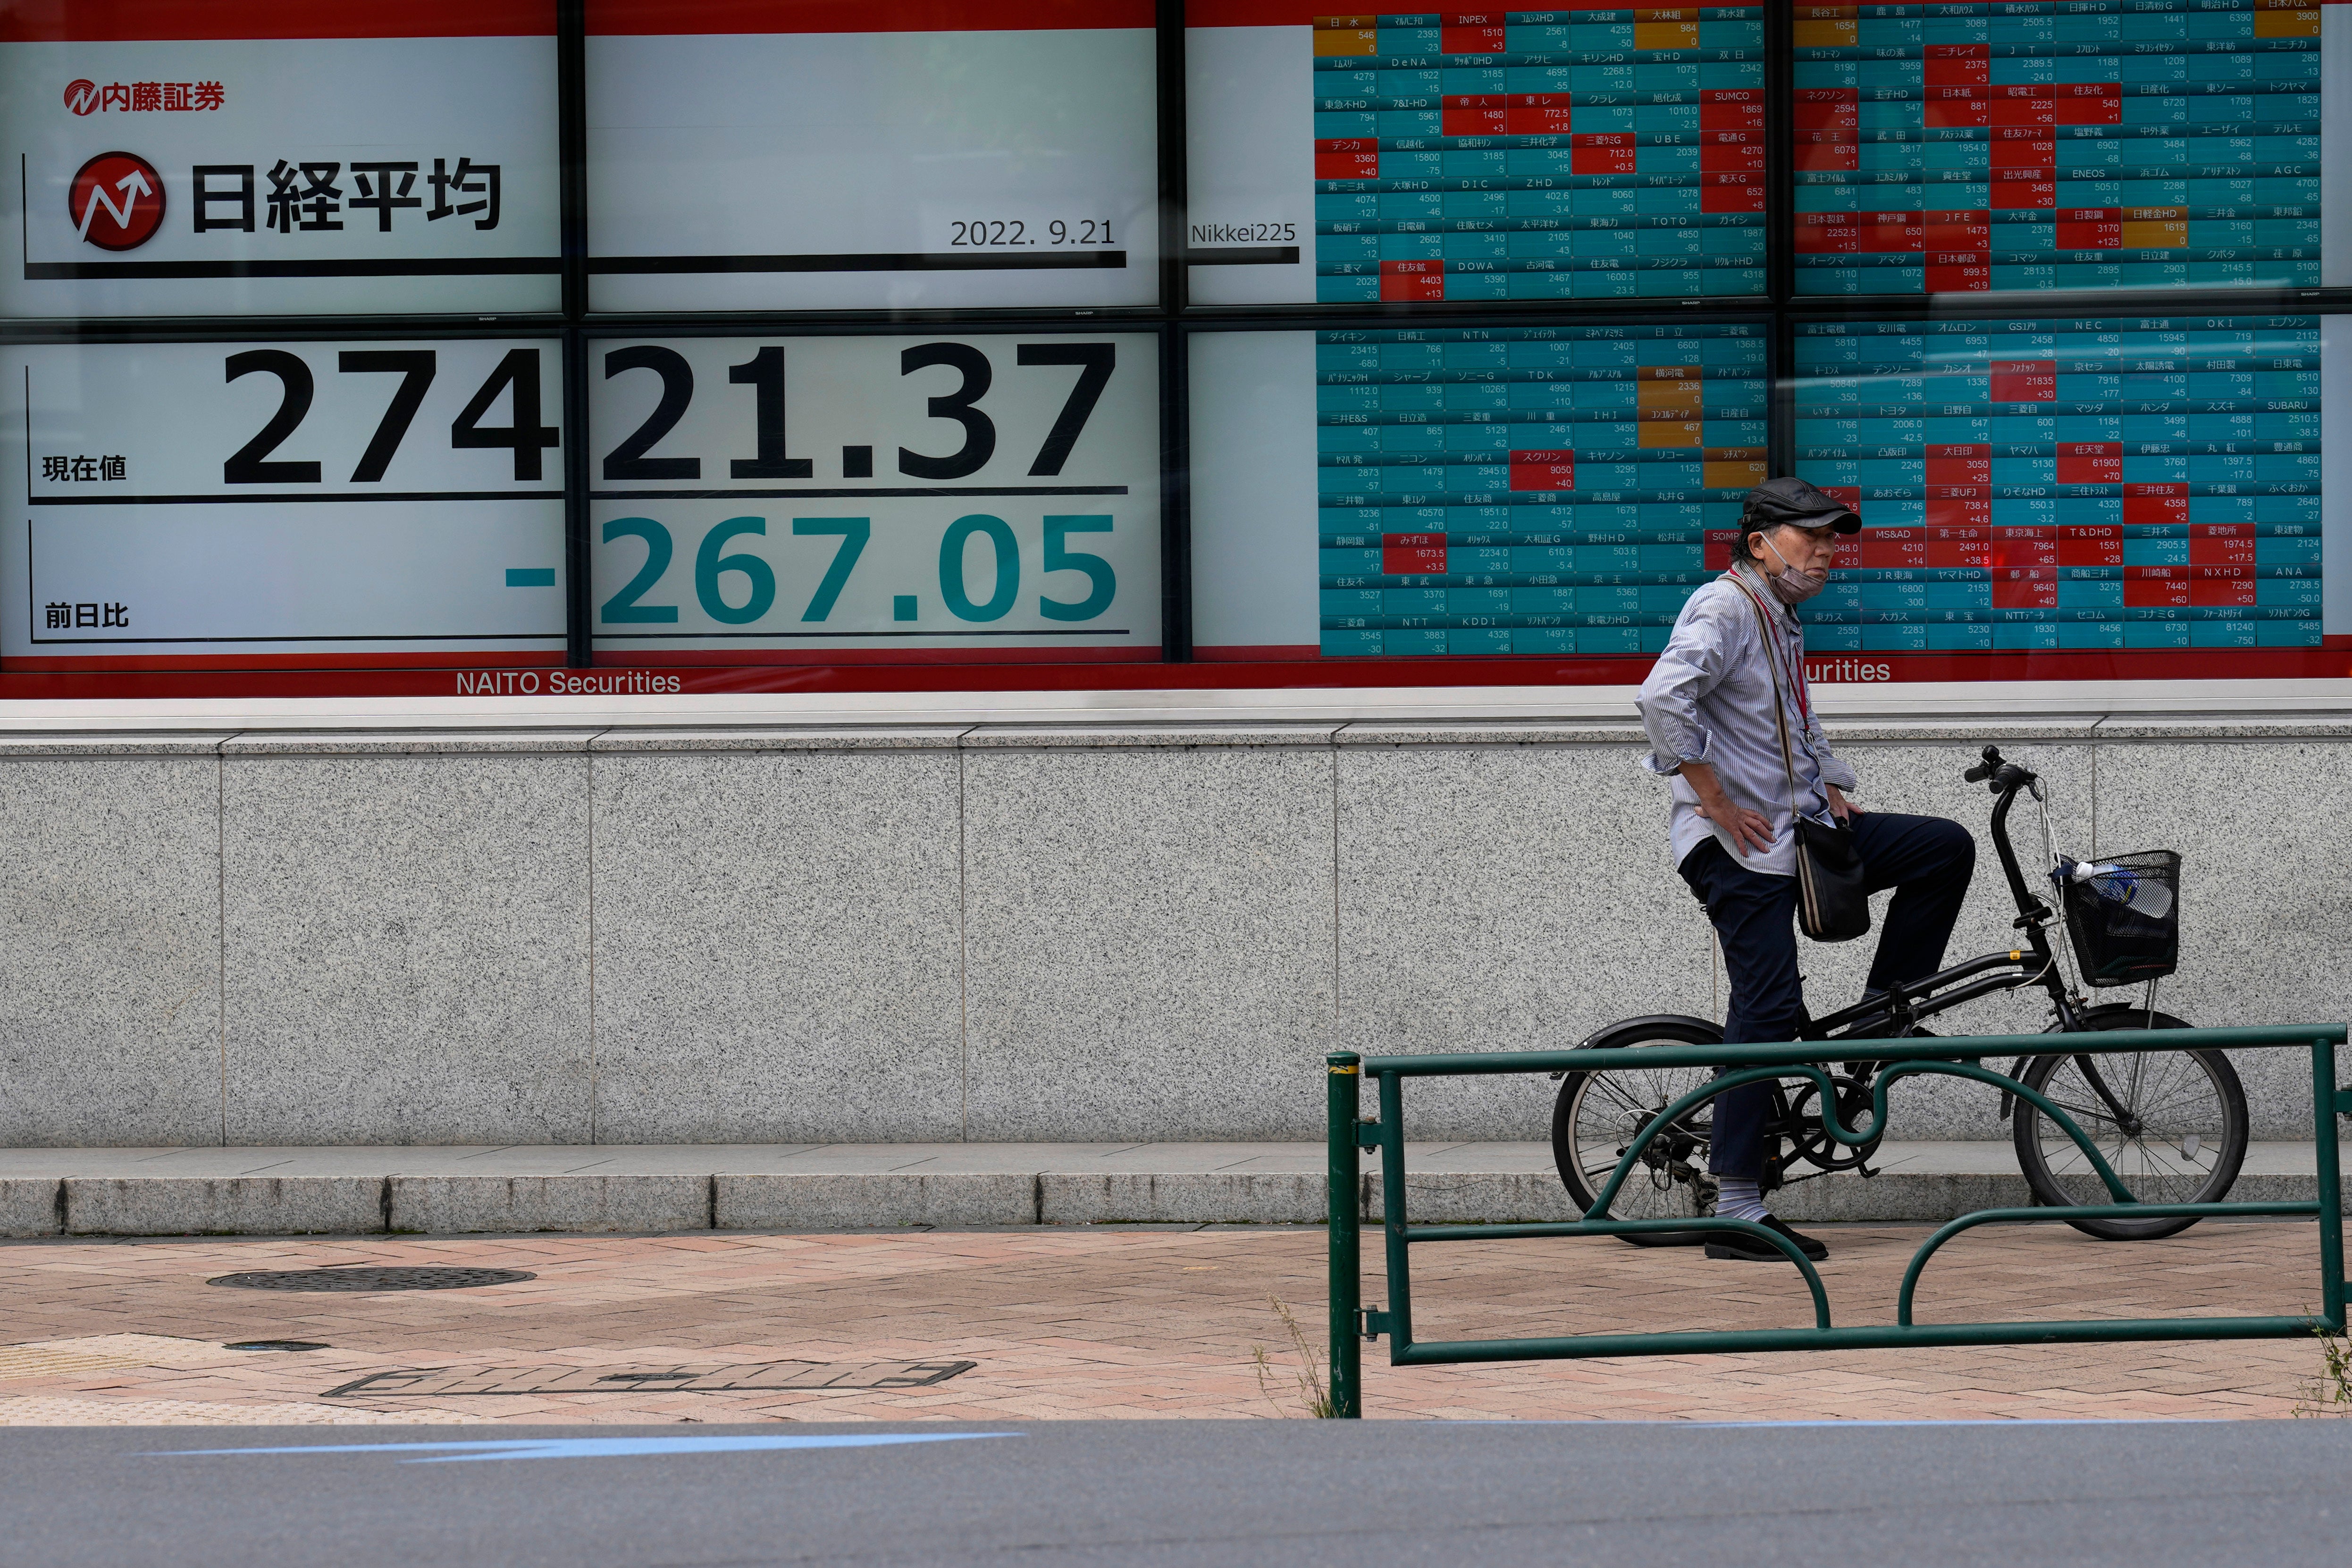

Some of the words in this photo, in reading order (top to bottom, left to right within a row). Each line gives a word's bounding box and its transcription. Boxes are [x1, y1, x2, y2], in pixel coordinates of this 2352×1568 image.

[1652, 10, 1680, 20] 大林組
[1812, 8, 1840, 17] 長谷工
[1459, 15, 1487, 24] INPEX
[1680, 24, 1696, 32] 984
[1835, 21, 1855, 30] 1654
[1482, 28, 1502, 36] 1510
[1691, 37, 1696, 45] 0
[1850, 35, 1856, 43] 0
[1492, 42, 1503, 50] +3
[2268, 40, 2306, 49] ユニチカ
[1938, 47, 1975, 56] ニチレイ
[1581, 53, 1623, 62] キリンHD
[2302, 53, 2318, 62] 280
[1965, 60, 1986, 68] 2375
[1603, 67, 1631, 75] 2268.5
[2304, 67, 2318, 75] -13
[1976, 74, 1986, 82] +3
[1610, 80, 1632, 88] -12.0
[2074, 85, 2102, 95] 住友化
[103, 82, 224, 111] 内藤証券
[1715, 92, 1749, 100] SUMCO
[1806, 90, 1845, 100] ネクソン
[1393, 99, 1427, 107] 7&I-HD
[2102, 99, 2118, 108] 540
[1741, 105, 1762, 113] 1869
[1834, 104, 1856, 113] 2594
[1419, 112, 1438, 120] 5961
[2108, 113, 2117, 121] +1
[1746, 118, 1762, 126] +16
[1840, 117, 1856, 126] +20
[2201, 125, 2239, 134] エーザイ
[1332, 140, 1360, 150] デンカ
[2230, 139, 2251, 147] 5962
[1355, 154, 1375, 162] 3360
[2237, 152, 2251, 160] -68
[1360, 168, 1376, 176] +40
[2003, 169, 2041, 179] 出光興産
[2073, 169, 2105, 177] ENEOS
[1747, 187, 1763, 195] 652
[2031, 184, 2053, 192] 3465
[2095, 183, 2118, 191] 505.0
[193, 157, 501, 233] 日経平均
[2036, 197, 2053, 205] +30
[2102, 196, 2118, 204] -0.4
[2134, 209, 2176, 219] 日軽金HD
[1808, 214, 1845, 224] 日本製鉄
[1398, 221, 1425, 231] 日電硝
[2164, 223, 2185, 231] 1619
[1192, 223, 1295, 243] Nikkei225
[1827, 228, 1856, 236] 2252.5
[1420, 235, 1440, 243] 2602
[2180, 236, 2185, 244] 0
[1838, 242, 1856, 250] +1.5
[1427, 248, 1441, 257] -20
[1939, 253, 1976, 263] 日本郵政
[1651, 258, 1687, 267] フジクラ
[1397, 262, 1426, 272] 住友鉱
[1683, 271, 1699, 279] 955
[1963, 268, 1987, 276] 999.5
[1420, 276, 1441, 284] 4403
[1968, 281, 1987, 289] +0.9
[1426, 289, 1441, 297] +13
[1329, 332, 1366, 341] ダイキン
[1351, 346, 1377, 354] 23415
[1358, 359, 1377, 367] -680
[2206, 360, 2235, 369] 村田製
[1394, 371, 1431, 381] シャープ
[1655, 368, 1684, 377] 横河電
[2230, 374, 2251, 382] 7309
[1426, 386, 1441, 394] 939
[1678, 382, 1699, 390] 2336
[2237, 387, 2251, 395] -84
[2268, 401, 2307, 410] SUBARU
[1721, 408, 1748, 418] 日産自
[1880, 406, 1906, 415] トヨタ
[1330, 414, 1367, 423] 三井E&S
[2288, 414, 2318, 423] 2510.5
[1741, 422, 1764, 430] 524.3
[1893, 419, 1922, 428] 2006.0
[2296, 428, 2318, 436] -38.5
[1743, 436, 1764, 444] -13.4
[1900, 433, 1922, 441] -42.5
[1370, 441, 1378, 449] -3
[2075, 444, 2104, 454] 任天堂
[1523, 452, 1560, 461] スクリン
[2092, 459, 2119, 467] 61900
[42, 455, 126, 482] 現在値
[1550, 466, 1571, 474] 9050
[2103, 472, 2119, 480] +70
[1556, 479, 1571, 487] +40
[1941, 487, 1976, 497] 三菱UFJ
[2137, 485, 2174, 495] 三井住友
[2268, 483, 2308, 493] ふくおか
[1463, 494, 1491, 503] 住友商
[2297, 497, 2318, 505] 2640
[1964, 501, 1988, 509] 738.4
[2164, 499, 2186, 507] 4358
[1479, 507, 1507, 516] 1951.0
[1680, 505, 1701, 513] 2485
[1970, 515, 1988, 523] +4.6
[2175, 512, 2186, 520] +2
[2305, 511, 2318, 519] -27
[1486, 521, 1507, 529] -22.0
[1687, 519, 1700, 527] -24
[1876, 530, 1910, 538] MS&AD
[2005, 528, 2043, 537] 東京海上
[2208, 526, 2236, 535] 菱地所
[1400, 535, 1428, 545] みずほ
[2224, 540, 2252, 548] 1974.5
[1902, 543, 1923, 552] 4210
[2033, 542, 2054, 550] 7964
[1416, 549, 1444, 557] 1673.5
[1907, 557, 1923, 565] +14
[2038, 555, 2054, 563] +65
[2228, 553, 2252, 562] +17.5
[1426, 562, 1444, 570] +3.5
[2142, 568, 2171, 577] 川崎船
[2165, 582, 2186, 590] 7440
[2170, 595, 2186, 604] +60
[45, 602, 128, 629] 前日比
[1587, 614, 1630, 624] 東電力HD
[1338, 618, 1365, 627] 三菱倉
[2165, 623, 2187, 631] 6730
[1360, 631, 1381, 639] 3545
[1621, 629, 1638, 637] 472
[2173, 637, 2187, 645] -10
[1368, 645, 1381, 653] -30
[1624, 642, 1638, 650] -12
[1806, 659, 1890, 681] urities
[457, 672, 539, 694] NAITO
[549, 671, 680, 693] Securities
